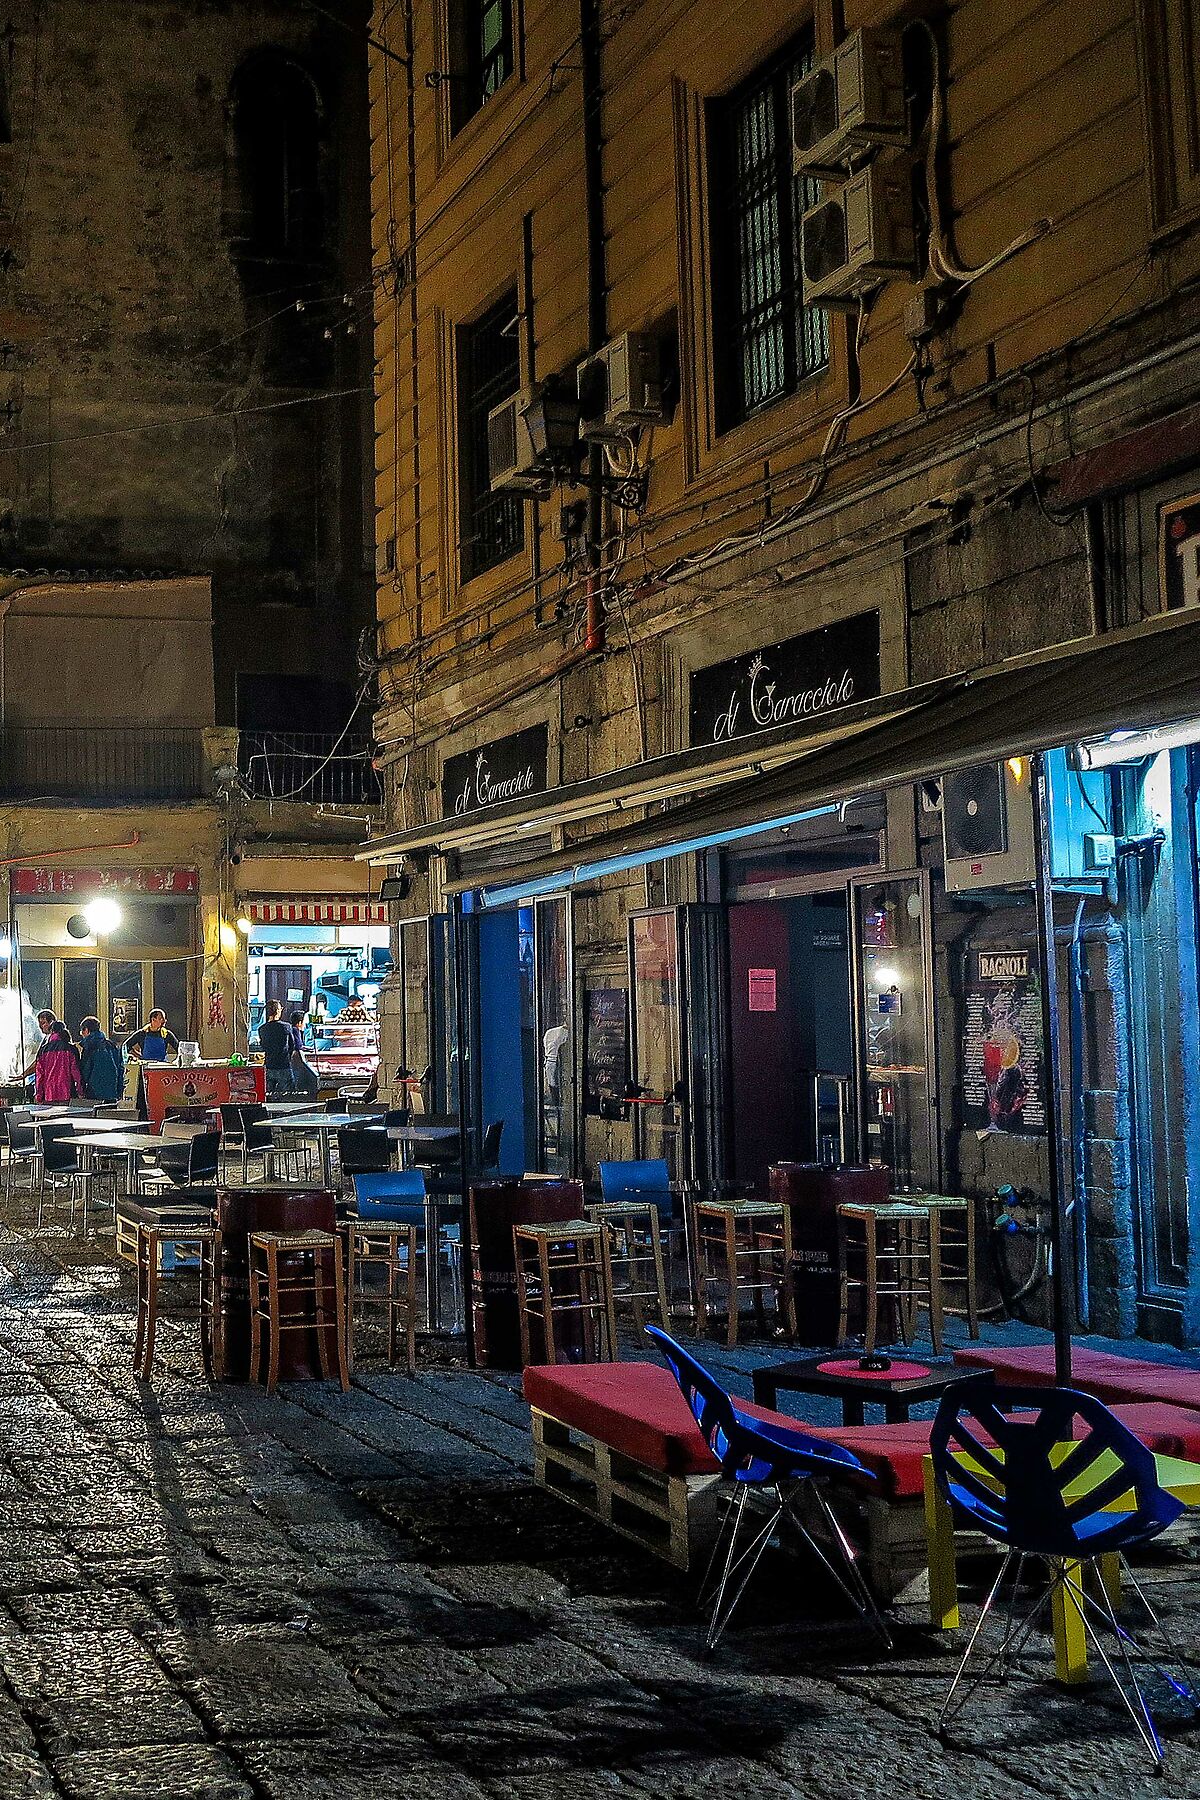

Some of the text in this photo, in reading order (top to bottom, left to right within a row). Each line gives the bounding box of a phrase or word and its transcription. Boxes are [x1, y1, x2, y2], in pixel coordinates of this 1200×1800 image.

[750, 665, 855, 726] Caracciolo
[476, 759, 534, 804] Caracciolo
[981, 956, 1028, 977] BAGNOLI
[162, 1072, 218, 1086] DA JOLLY
